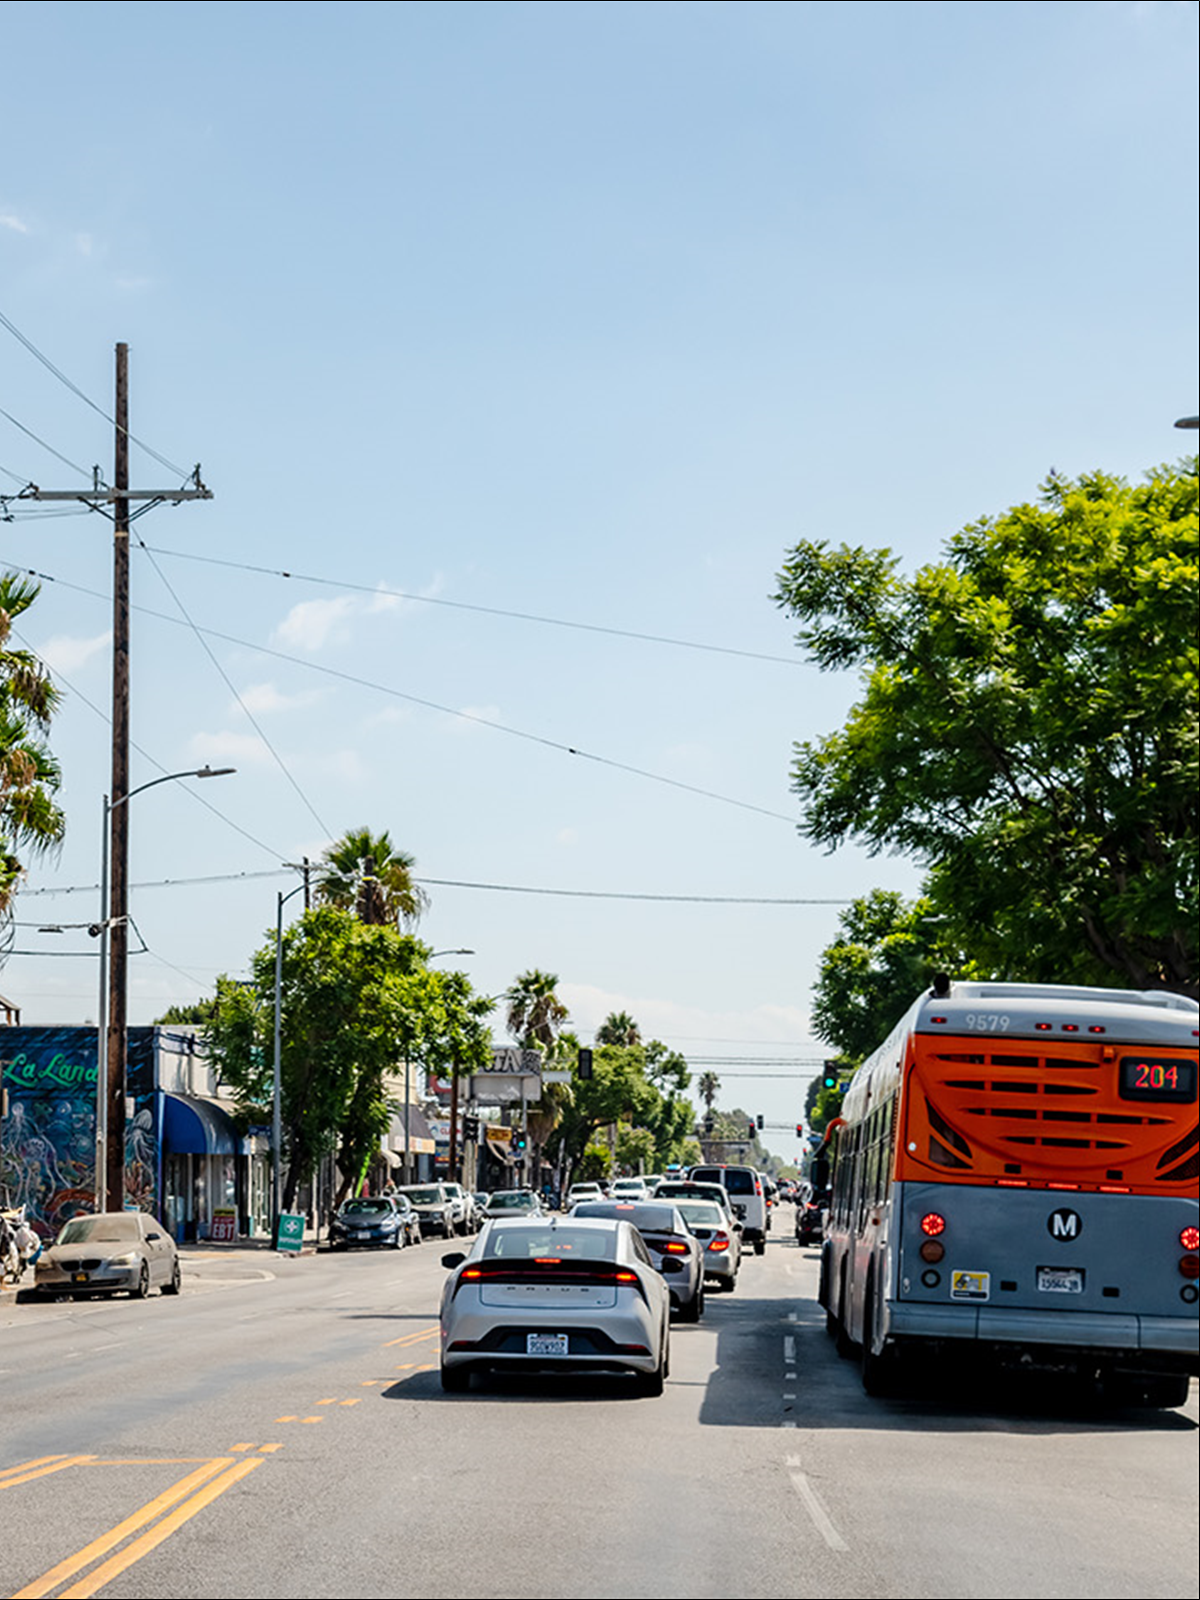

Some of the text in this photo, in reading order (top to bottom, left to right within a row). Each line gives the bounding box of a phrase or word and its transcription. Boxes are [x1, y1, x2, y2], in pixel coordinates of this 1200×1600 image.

[966, 1014, 1010, 1032] 9579
[3, 1053, 99, 1088] La Land
[1135, 1064, 1178, 1089] 204
[212, 1223, 234, 1240] EBT
[1052, 1213, 1077, 1237] M
